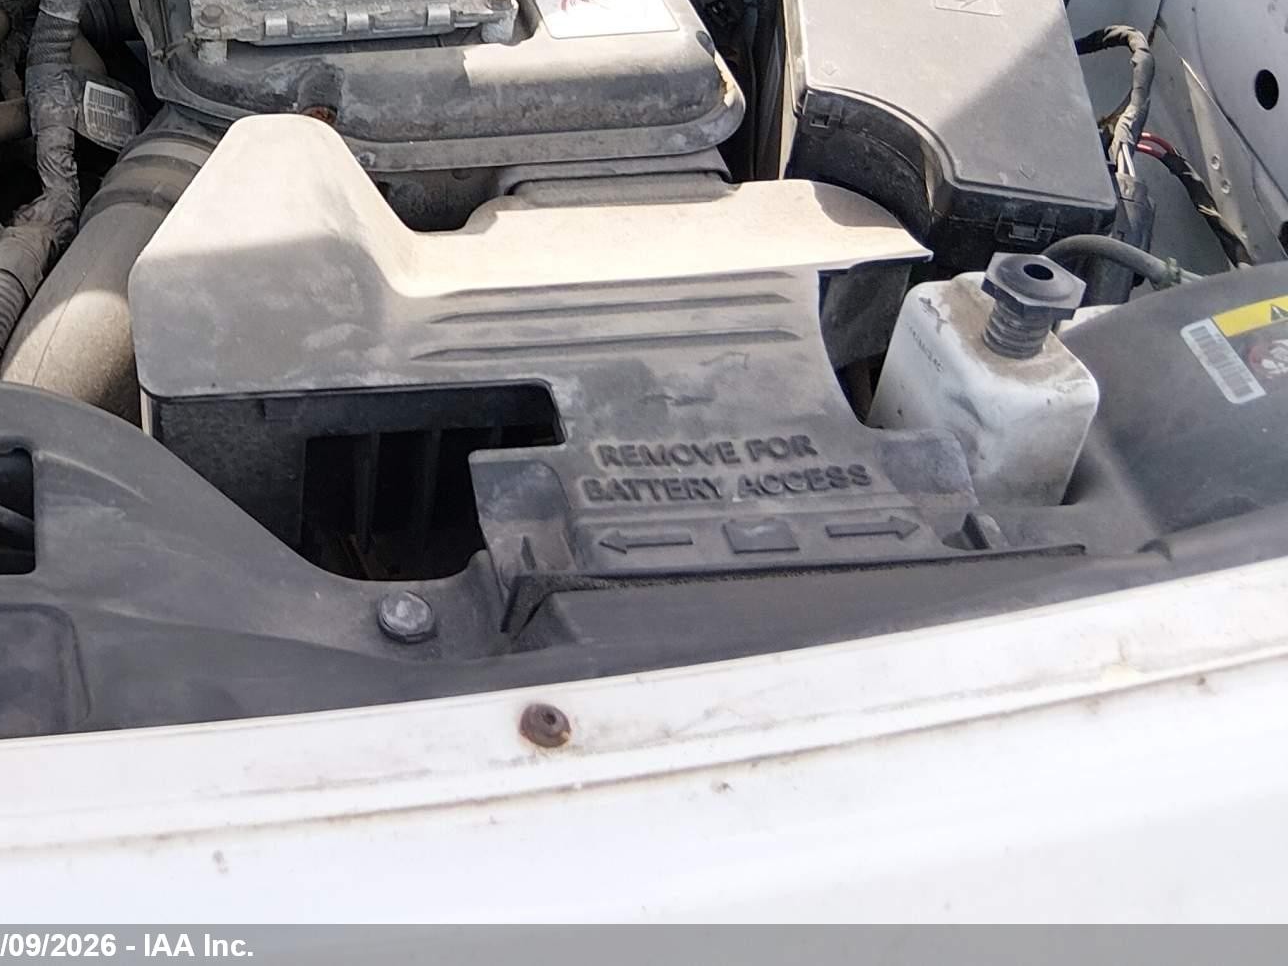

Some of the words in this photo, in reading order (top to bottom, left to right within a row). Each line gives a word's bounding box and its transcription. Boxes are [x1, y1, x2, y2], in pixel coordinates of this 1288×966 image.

[596, 441, 741, 466] REMOVE
[745, 434, 818, 462] FOR
[582, 477, 723, 501] BATTERY
[736, 463, 872, 498] ACCESS
